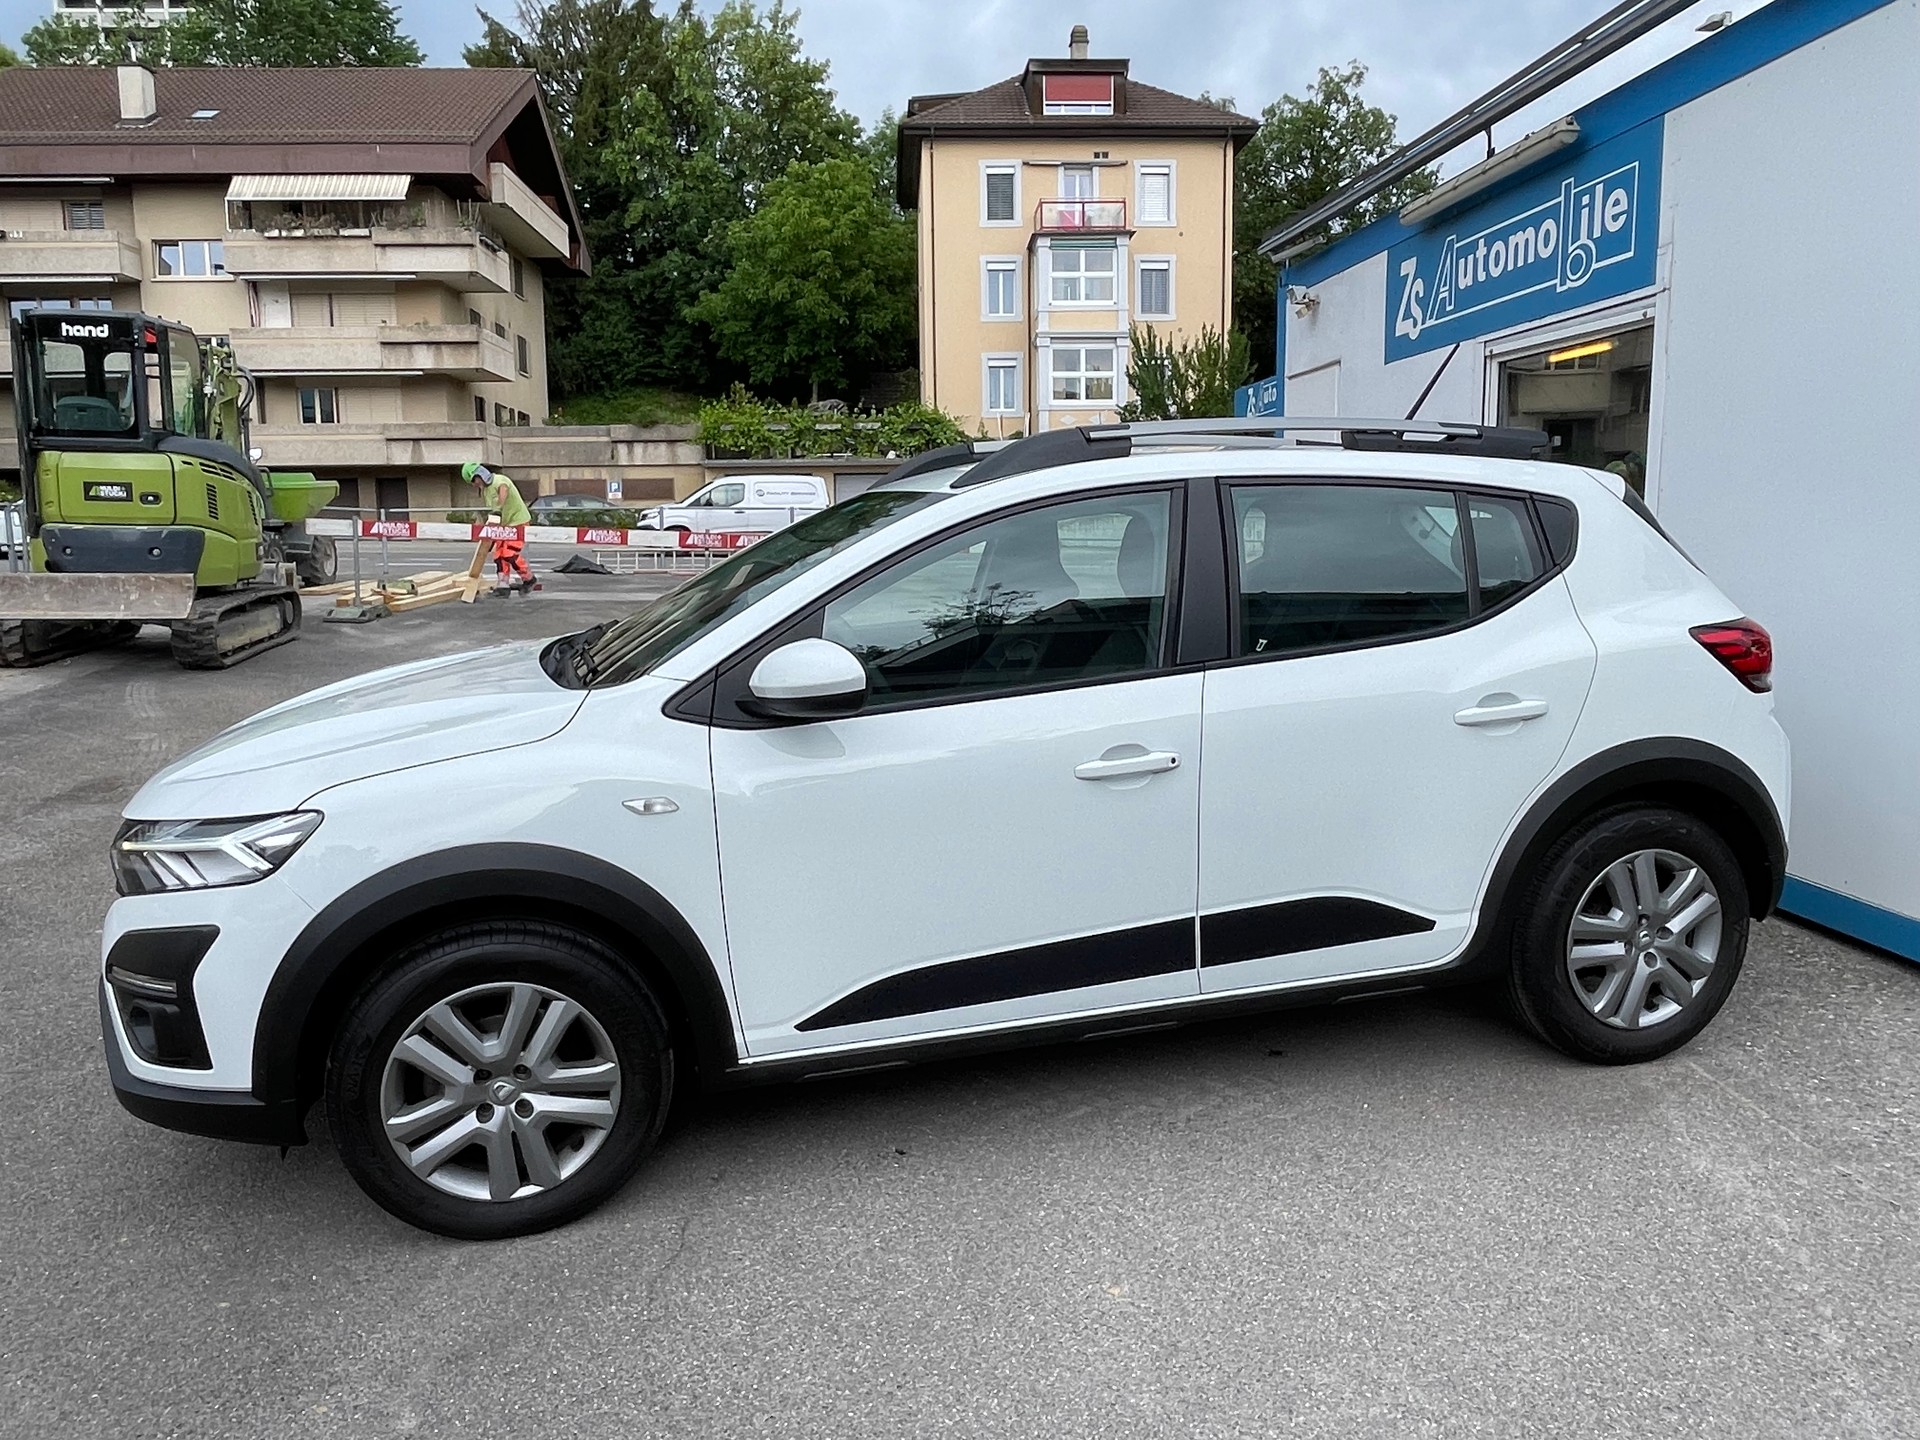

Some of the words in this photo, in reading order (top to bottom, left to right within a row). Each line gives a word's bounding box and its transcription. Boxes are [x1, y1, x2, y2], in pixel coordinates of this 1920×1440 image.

[1395, 256, 1424, 340] Zs
[1426, 177, 1628, 322] Automobile
[61, 321, 109, 338] hand
[611, 482, 619, 492] P
